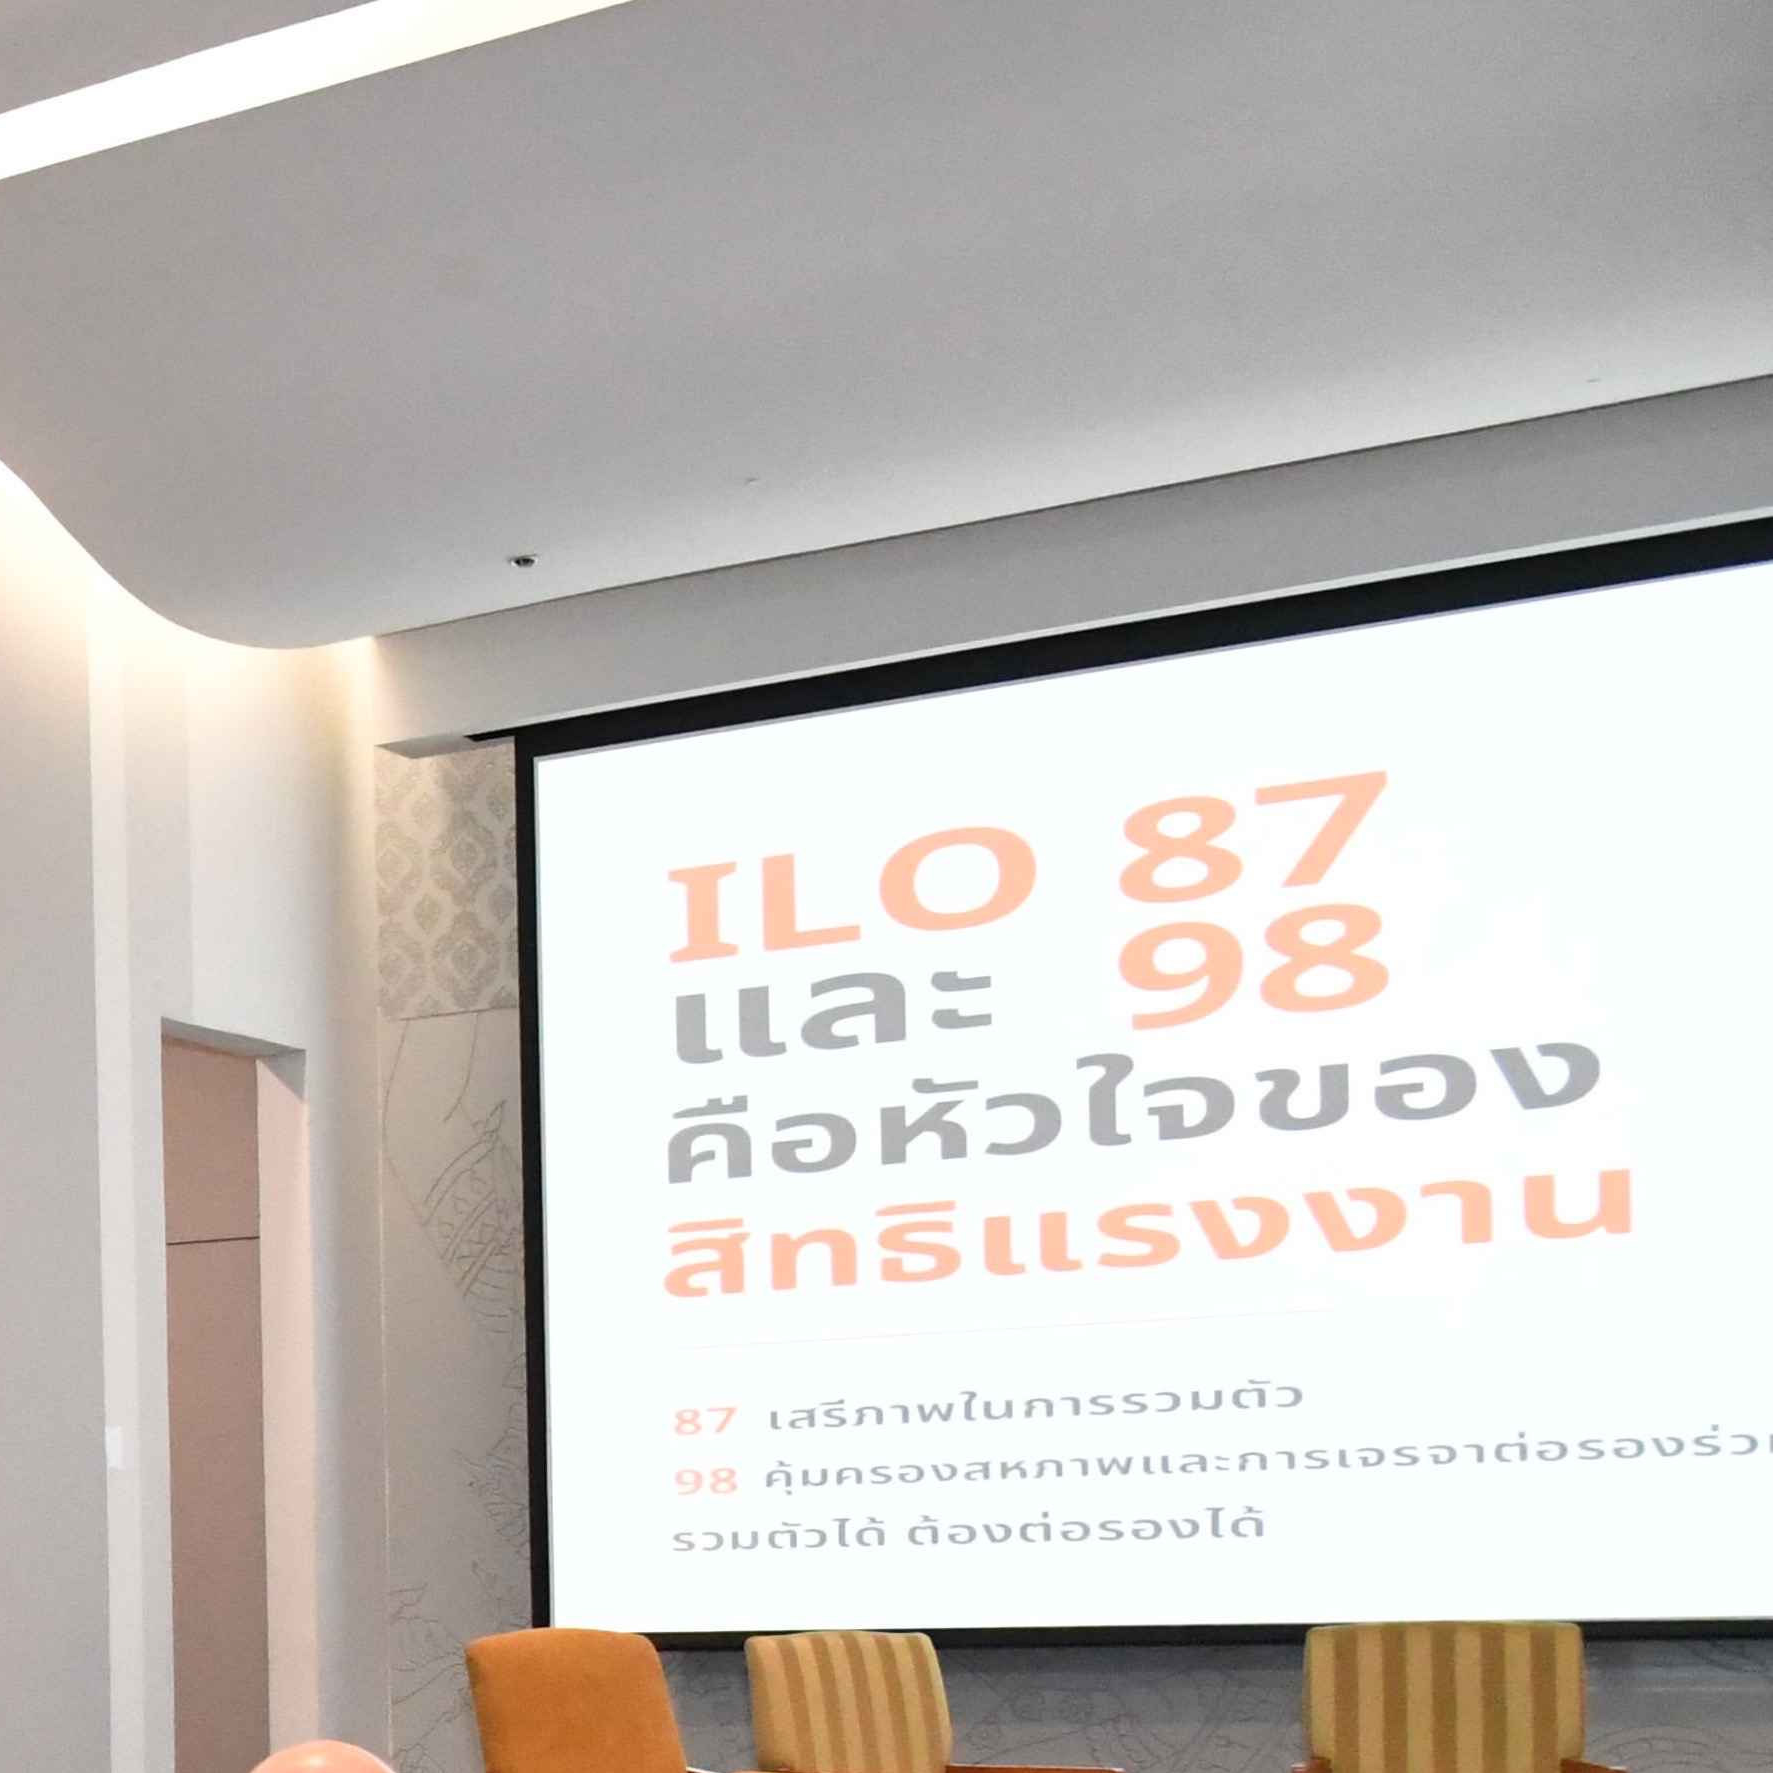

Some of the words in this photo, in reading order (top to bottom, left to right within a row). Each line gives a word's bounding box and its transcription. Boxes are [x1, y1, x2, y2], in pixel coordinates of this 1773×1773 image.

[668, 825, 1038, 963] ILO
[1118, 769, 1389, 904] 87
[675, 969, 993, 1065] และ
[1118, 901, 1390, 1032] 98
[667, 1040, 1602, 1185] คือหัวใจของ
[663, 1167, 1633, 1299] สิทธิแรงงาน
[674, 1406, 738, 1436] 87
[770, 1379, 1303, 1431] เสรีภาพในการรวมตัว
[675, 1467, 739, 1496] 98
[765, 1423, 1773, 1496] คุ้มครองสหภาพและการเจรจาต่อรองร่ว
[673, 1516, 886, 1552] รวมตัวได้
[907, 1505, 1265, 1547] ต้องต่อรองได้
